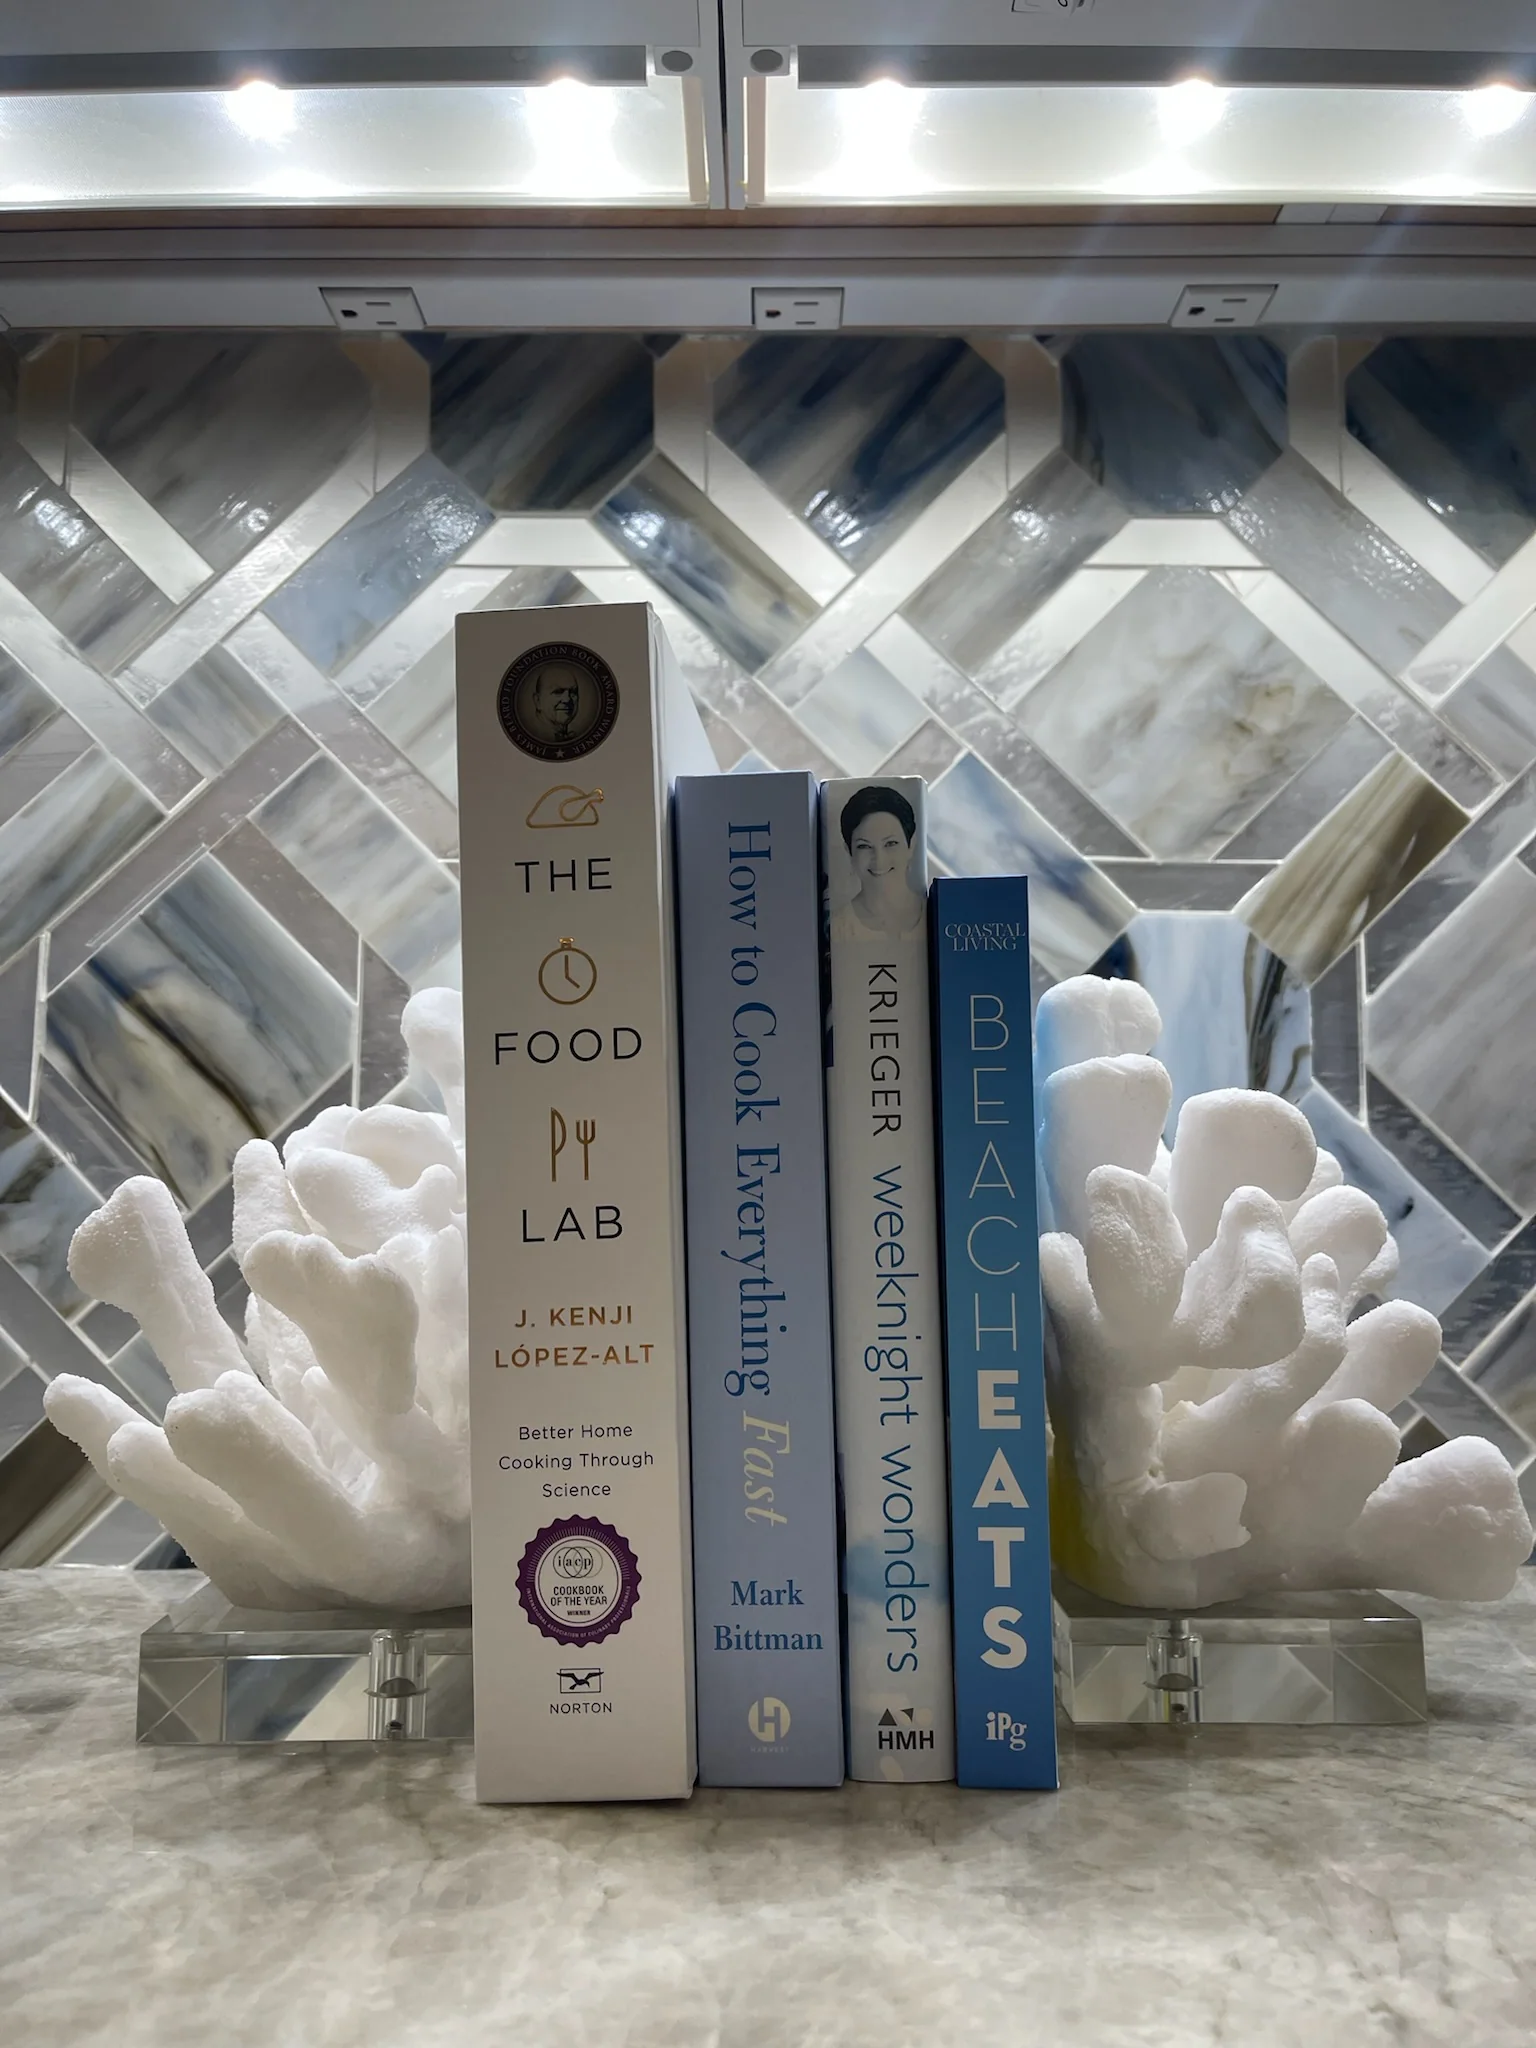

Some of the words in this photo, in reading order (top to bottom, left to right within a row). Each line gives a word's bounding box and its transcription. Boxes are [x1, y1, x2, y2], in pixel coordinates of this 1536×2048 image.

[503, 646, 568, 693] FOUNDATION
[572, 648, 601, 671] BOOK
[601, 675, 615, 716] AWARD
[502, 697, 517, 733] BEARD
[516, 734, 547, 756] JAMES
[572, 718, 611, 754] WINNER
[514, 857, 612, 893] THE
[728, 820, 772, 931] How
[944, 922, 1026, 938] COASTAL
[953, 937, 1017, 952] LIVING
[730, 945, 765, 986] to
[494, 1027, 642, 1066] FOOD
[867, 963, 902, 1137] KRIEGER
[732, 1002, 781, 1126] Cook
[967, 994, 1020, 1351] BEACH
[522, 1205, 624, 1243] LAB
[720, 1143, 788, 1397] Everything
[514, 1309, 536, 1328] J.
[550, 1305, 632, 1326] KENJI
[495, 1344, 654, 1368] LÓPEZ-ALT
[519, 1426, 574, 1440] Better
[581, 1424, 633, 1438] Home
[498, 1454, 572, 1471] Cooking
[579, 1451, 654, 1468] Through
[743, 1410, 791, 1527] Fast
[542, 1483, 611, 1498] Science
[972, 1370, 1030, 1669] EATS
[558, 1556, 591, 1570] iacp
[880, 1444, 930, 1673] wonders
[550, 1597, 562, 1606] OF
[564, 1597, 581, 1606] THE
[584, 1596, 608, 1605] YEAR
[553, 1585, 604, 1596] COOKBOOK
[730, 1579, 804, 1606] Mark
[713, 1624, 824, 1651] Bittman
[550, 1702, 612, 1714] NORTON
[878, 1729, 935, 1750] HMH
